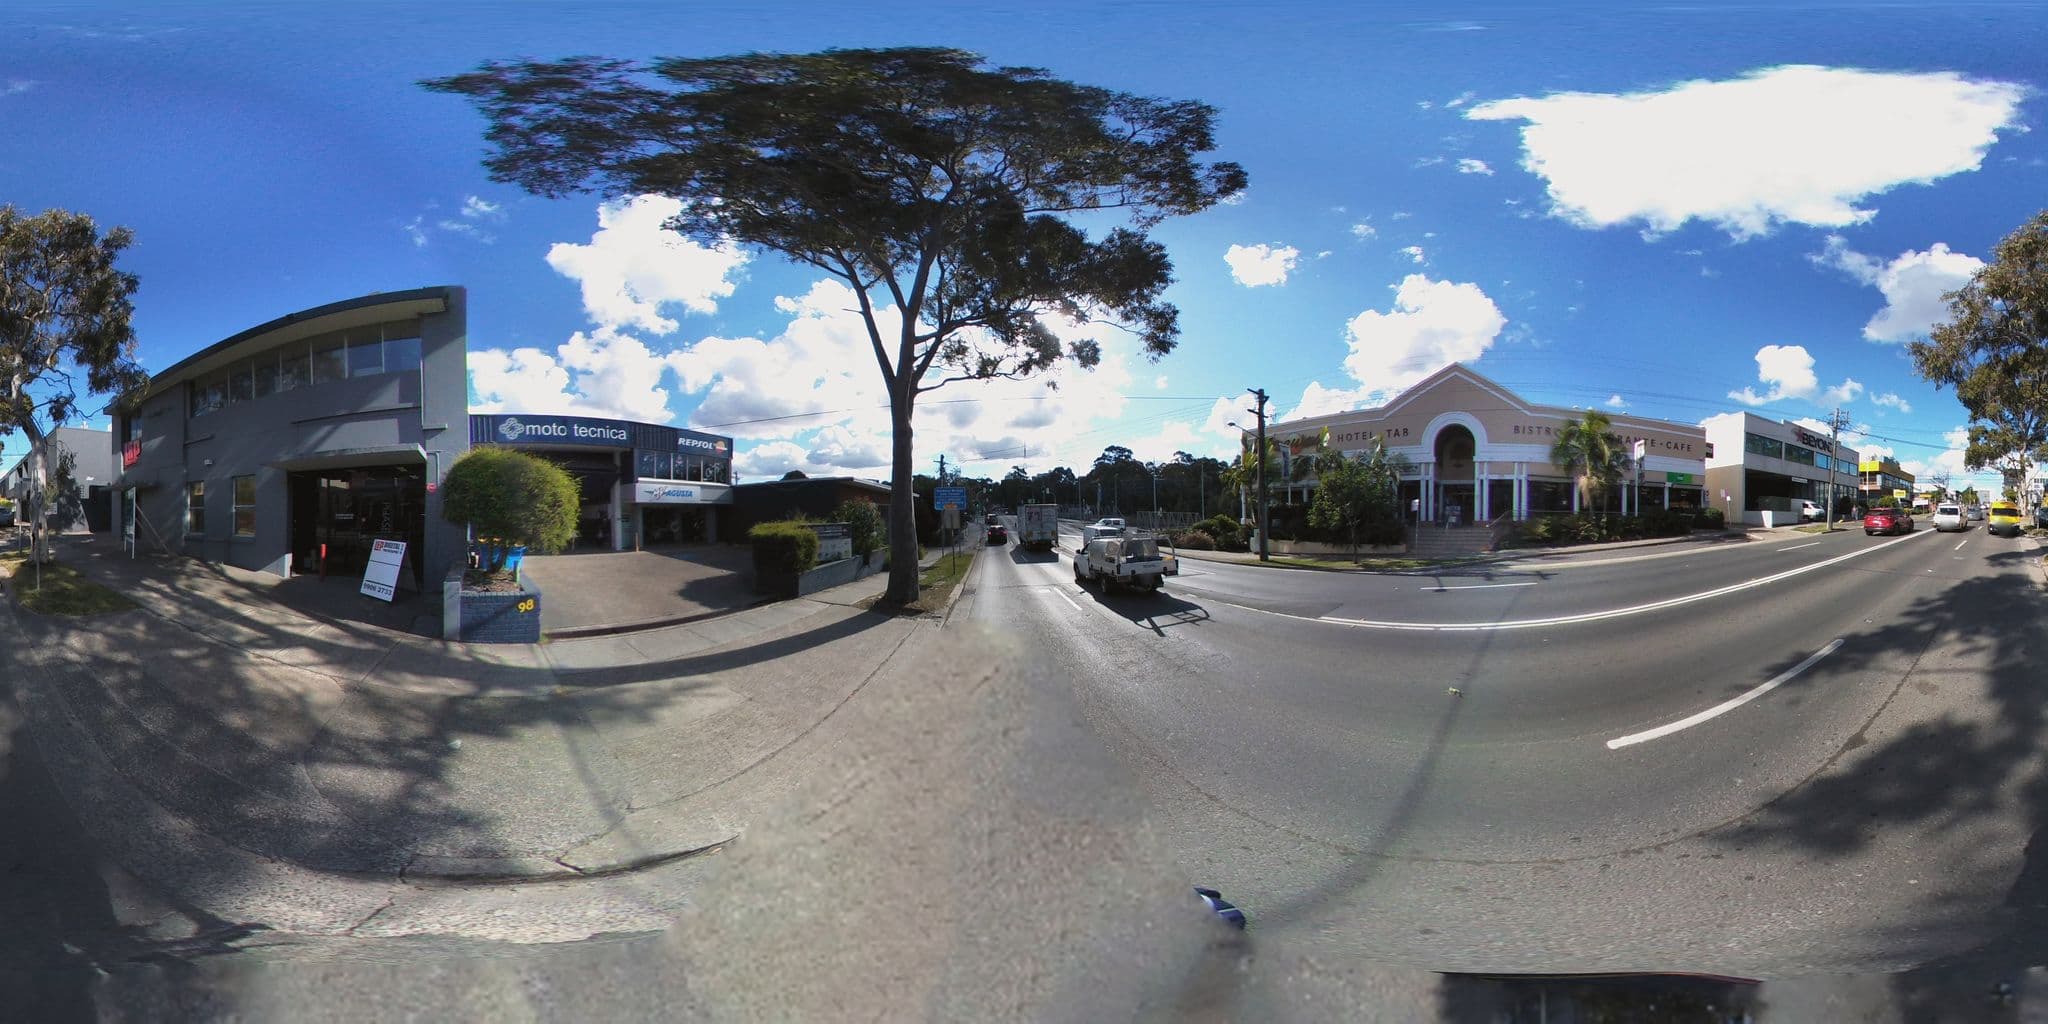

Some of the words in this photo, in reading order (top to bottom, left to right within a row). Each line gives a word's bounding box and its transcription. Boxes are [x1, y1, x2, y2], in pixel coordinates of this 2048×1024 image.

[525, 422, 568, 437] moto
[573, 423, 627, 440] tecnica
[1337, 431, 1374, 443] HOTEL
[1386, 428, 1410, 439] TAB
[678, 437, 714, 450] REPSOL
[1666, 441, 1693, 452] CAFE
[665, 489, 694, 497] AGUSTA
[518, 598, 534, 613] 98
